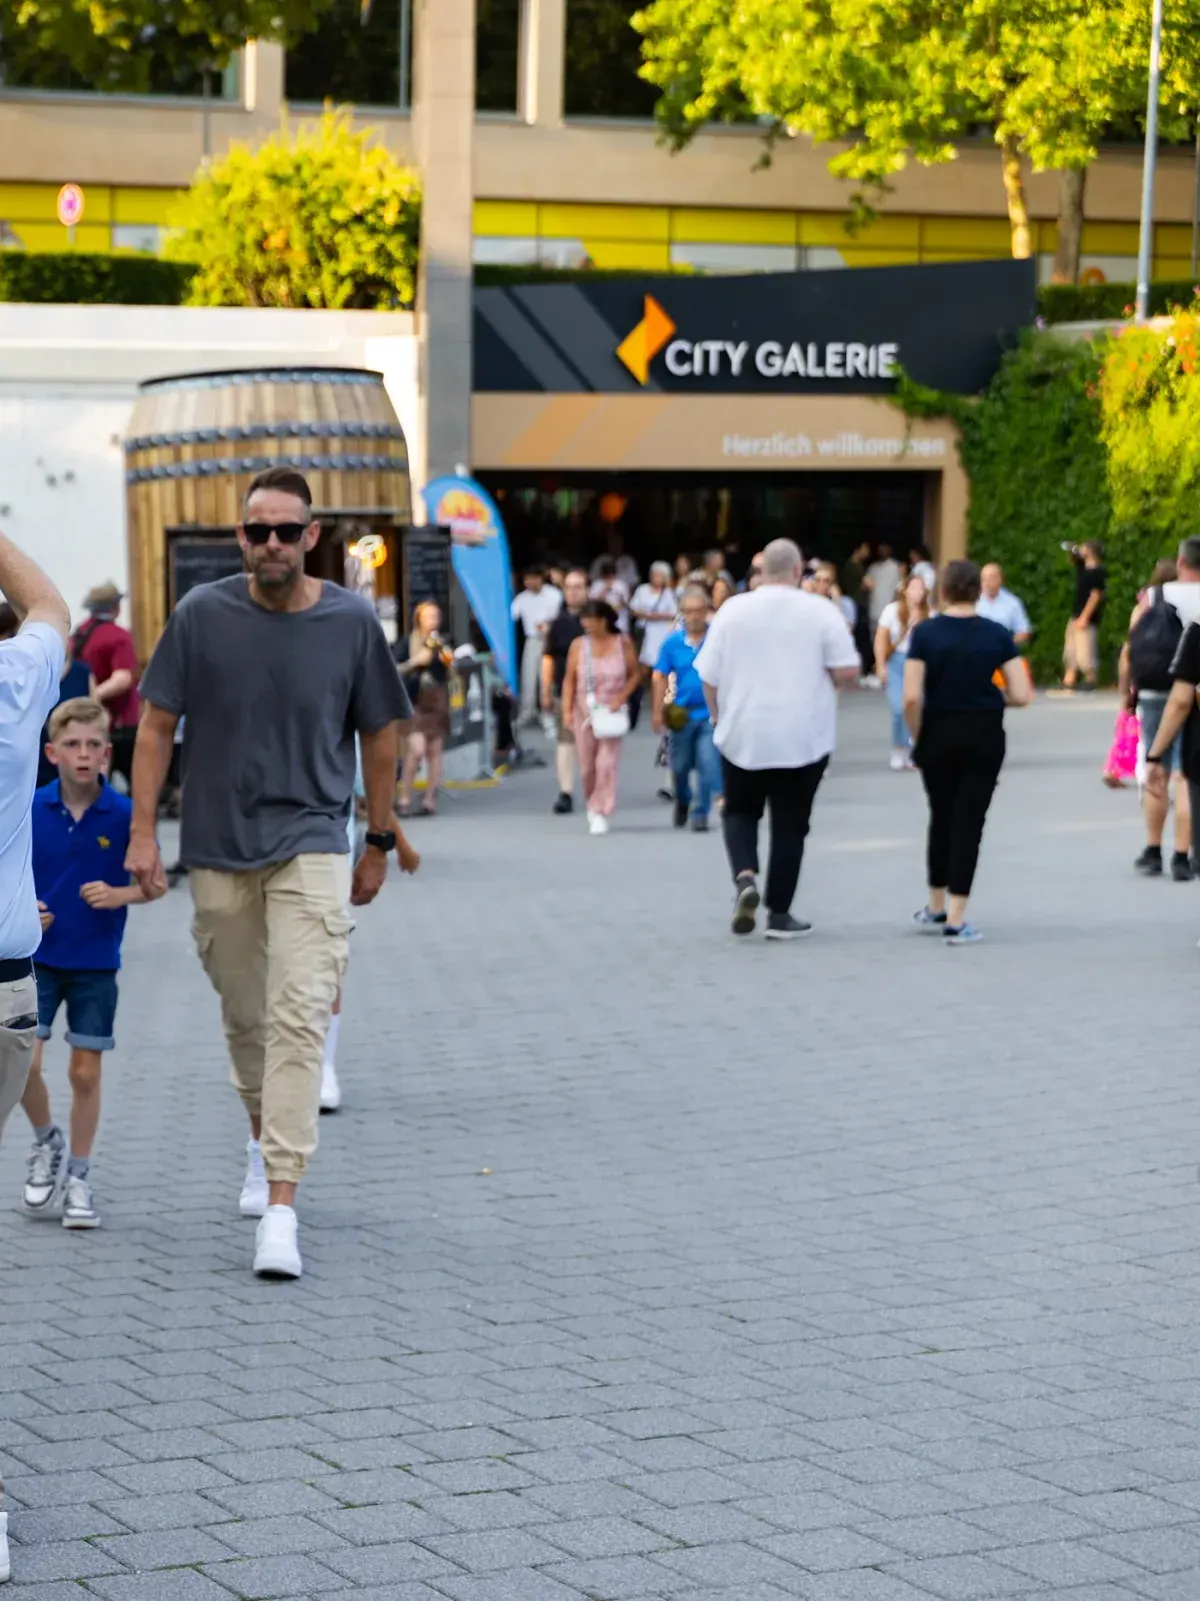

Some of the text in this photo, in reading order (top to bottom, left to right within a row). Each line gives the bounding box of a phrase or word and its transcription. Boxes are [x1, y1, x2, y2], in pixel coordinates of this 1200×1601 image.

[665, 339, 898, 377] CITY GALERIE
[722, 432, 813, 457] Herzlich
